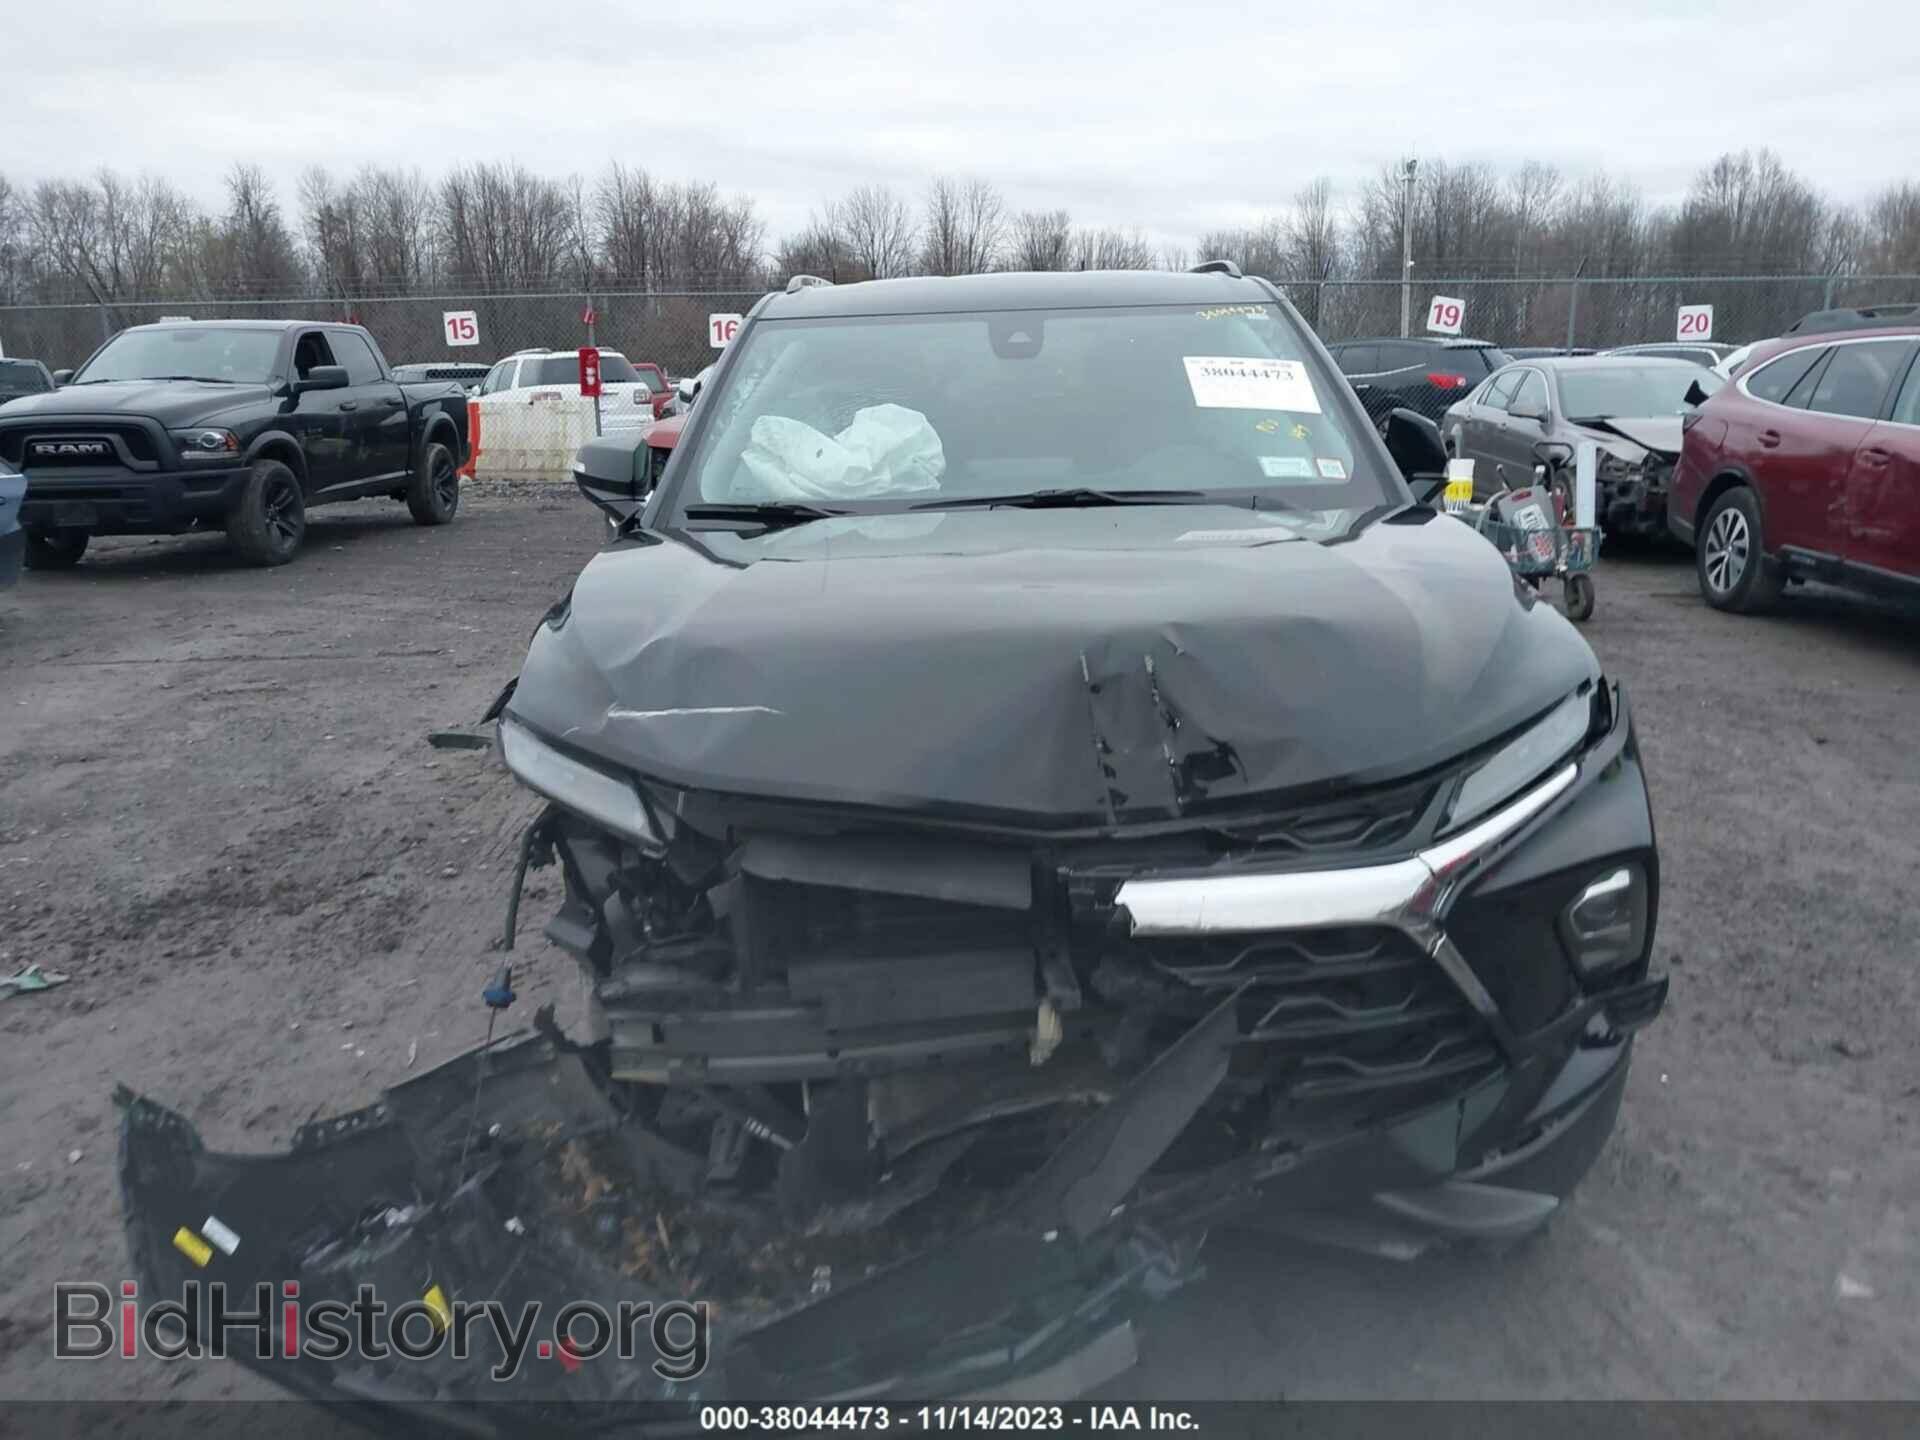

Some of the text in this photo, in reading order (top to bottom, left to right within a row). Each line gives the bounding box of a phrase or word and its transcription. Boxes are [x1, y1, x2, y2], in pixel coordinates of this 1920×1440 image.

[1433, 303, 1461, 327] 19
[1680, 313, 1709, 333] 20
[447, 318, 475, 340] 15
[712, 319, 738, 341] 16
[1200, 367, 1294, 381] 38044473
[35, 444, 104, 455] RAM
